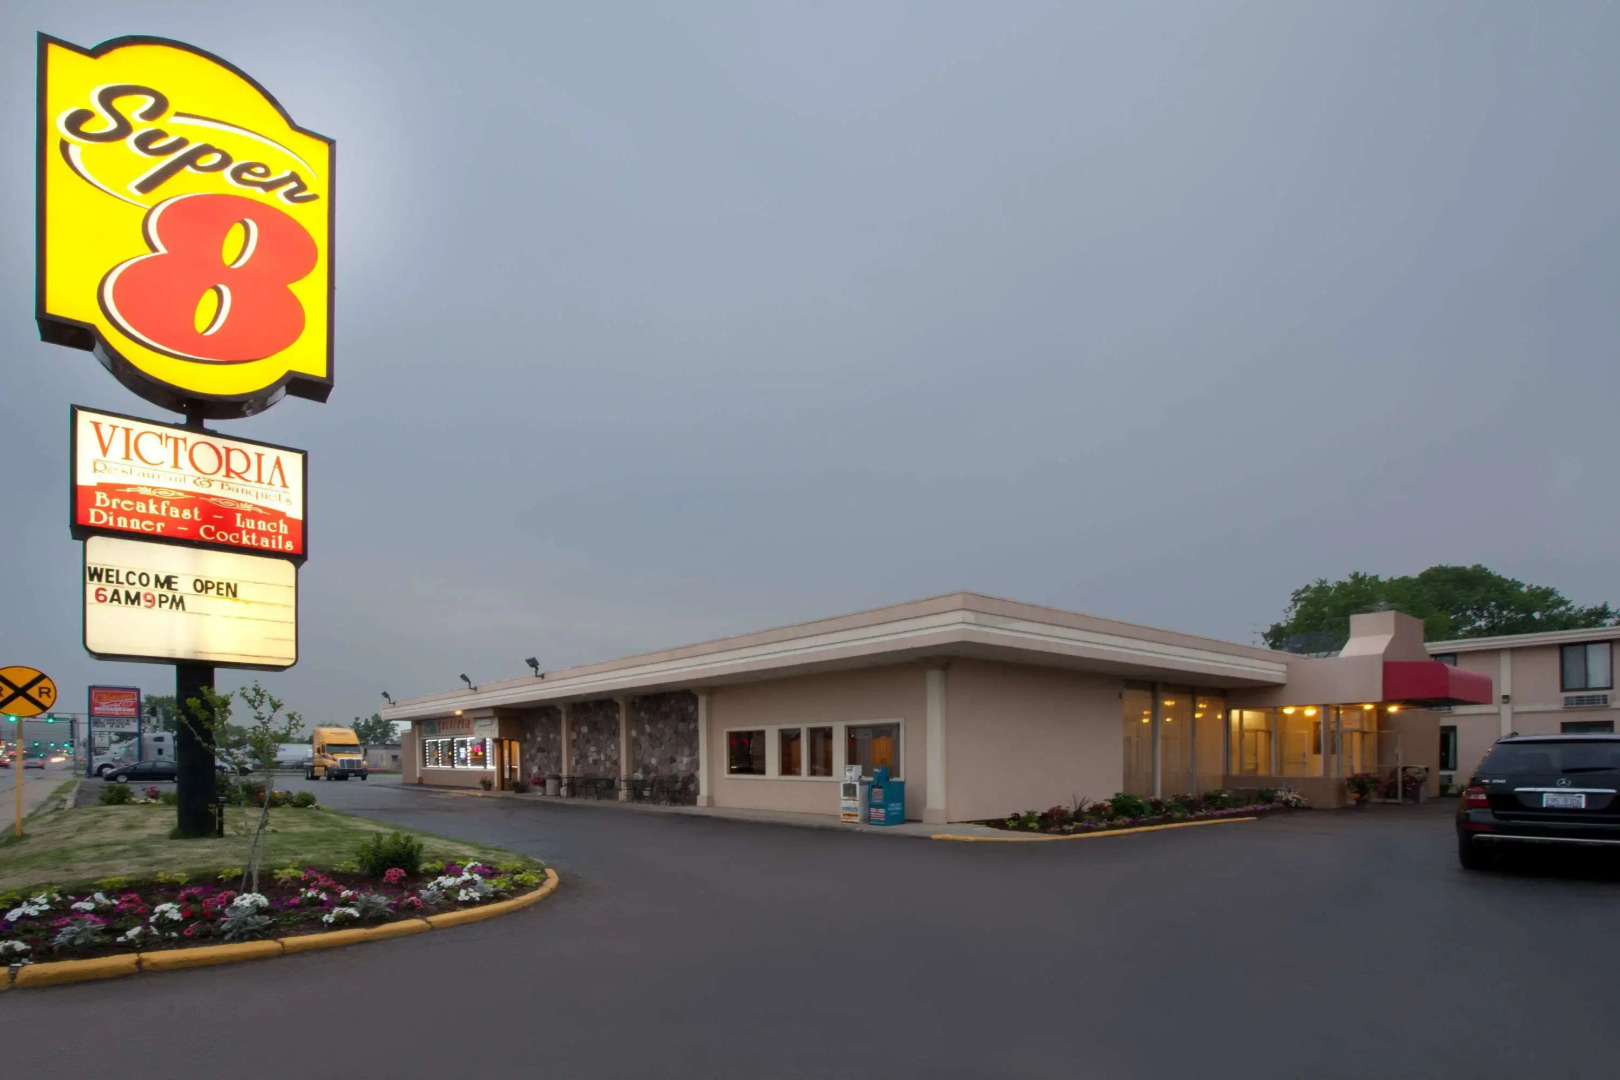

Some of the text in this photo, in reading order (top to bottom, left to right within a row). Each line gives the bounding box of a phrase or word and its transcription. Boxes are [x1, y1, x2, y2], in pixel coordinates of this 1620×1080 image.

[57, 83, 320, 206] Super
[96, 192, 319, 366] 8
[89, 420, 290, 489] VICTORIA
[94, 491, 202, 521] Breakfast
[235, 512, 289, 534] Lunch
[220, 481, 292, 506] Banquets
[88, 508, 166, 533] Dinner
[199, 524, 294, 551] Cocktails
[87, 565, 238, 598] WELCOME OPEN
[38, 686, 52, 699] R
